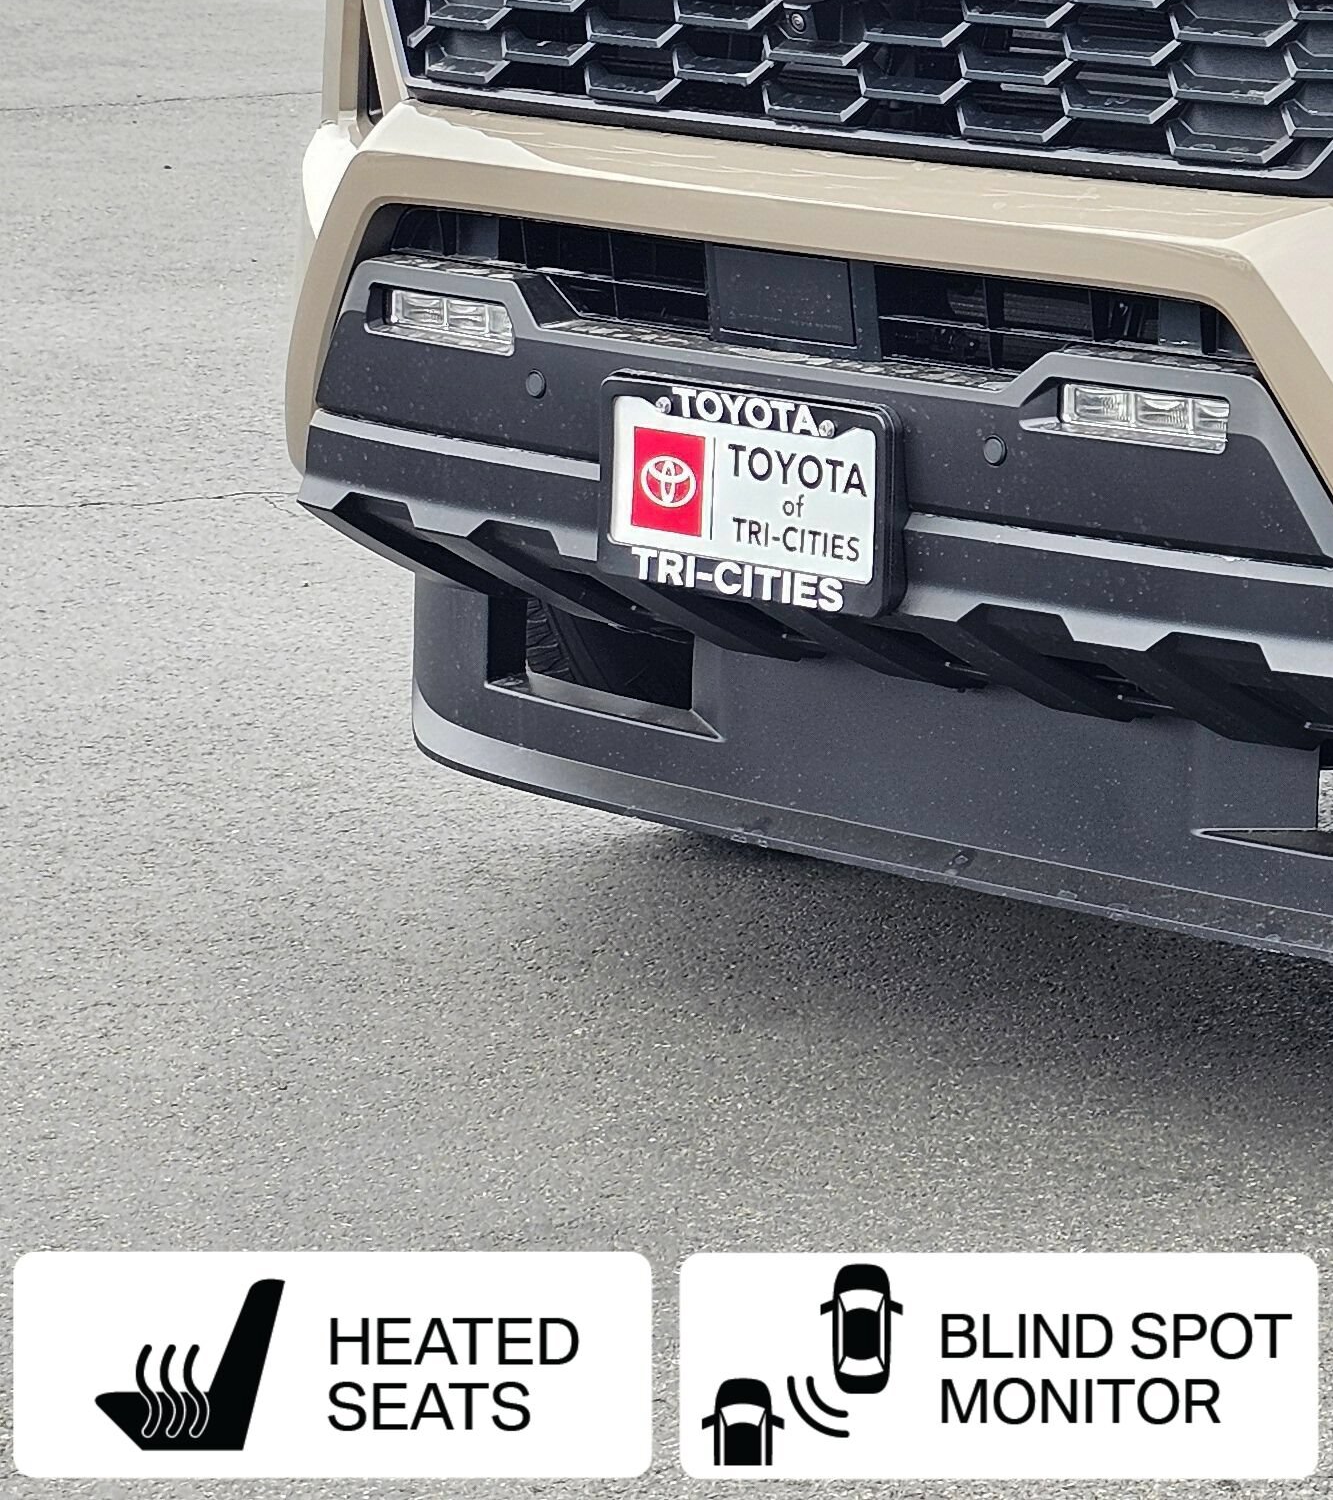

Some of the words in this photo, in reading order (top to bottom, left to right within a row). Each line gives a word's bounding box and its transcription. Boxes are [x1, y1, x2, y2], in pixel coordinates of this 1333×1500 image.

[671, 386, 821, 438] TOYOTA
[728, 443, 868, 498] TOYOTA
[782, 494, 804, 518] of
[732, 517, 861, 563] TRI-CITIES
[631, 547, 845, 613] TRI-CITIES
